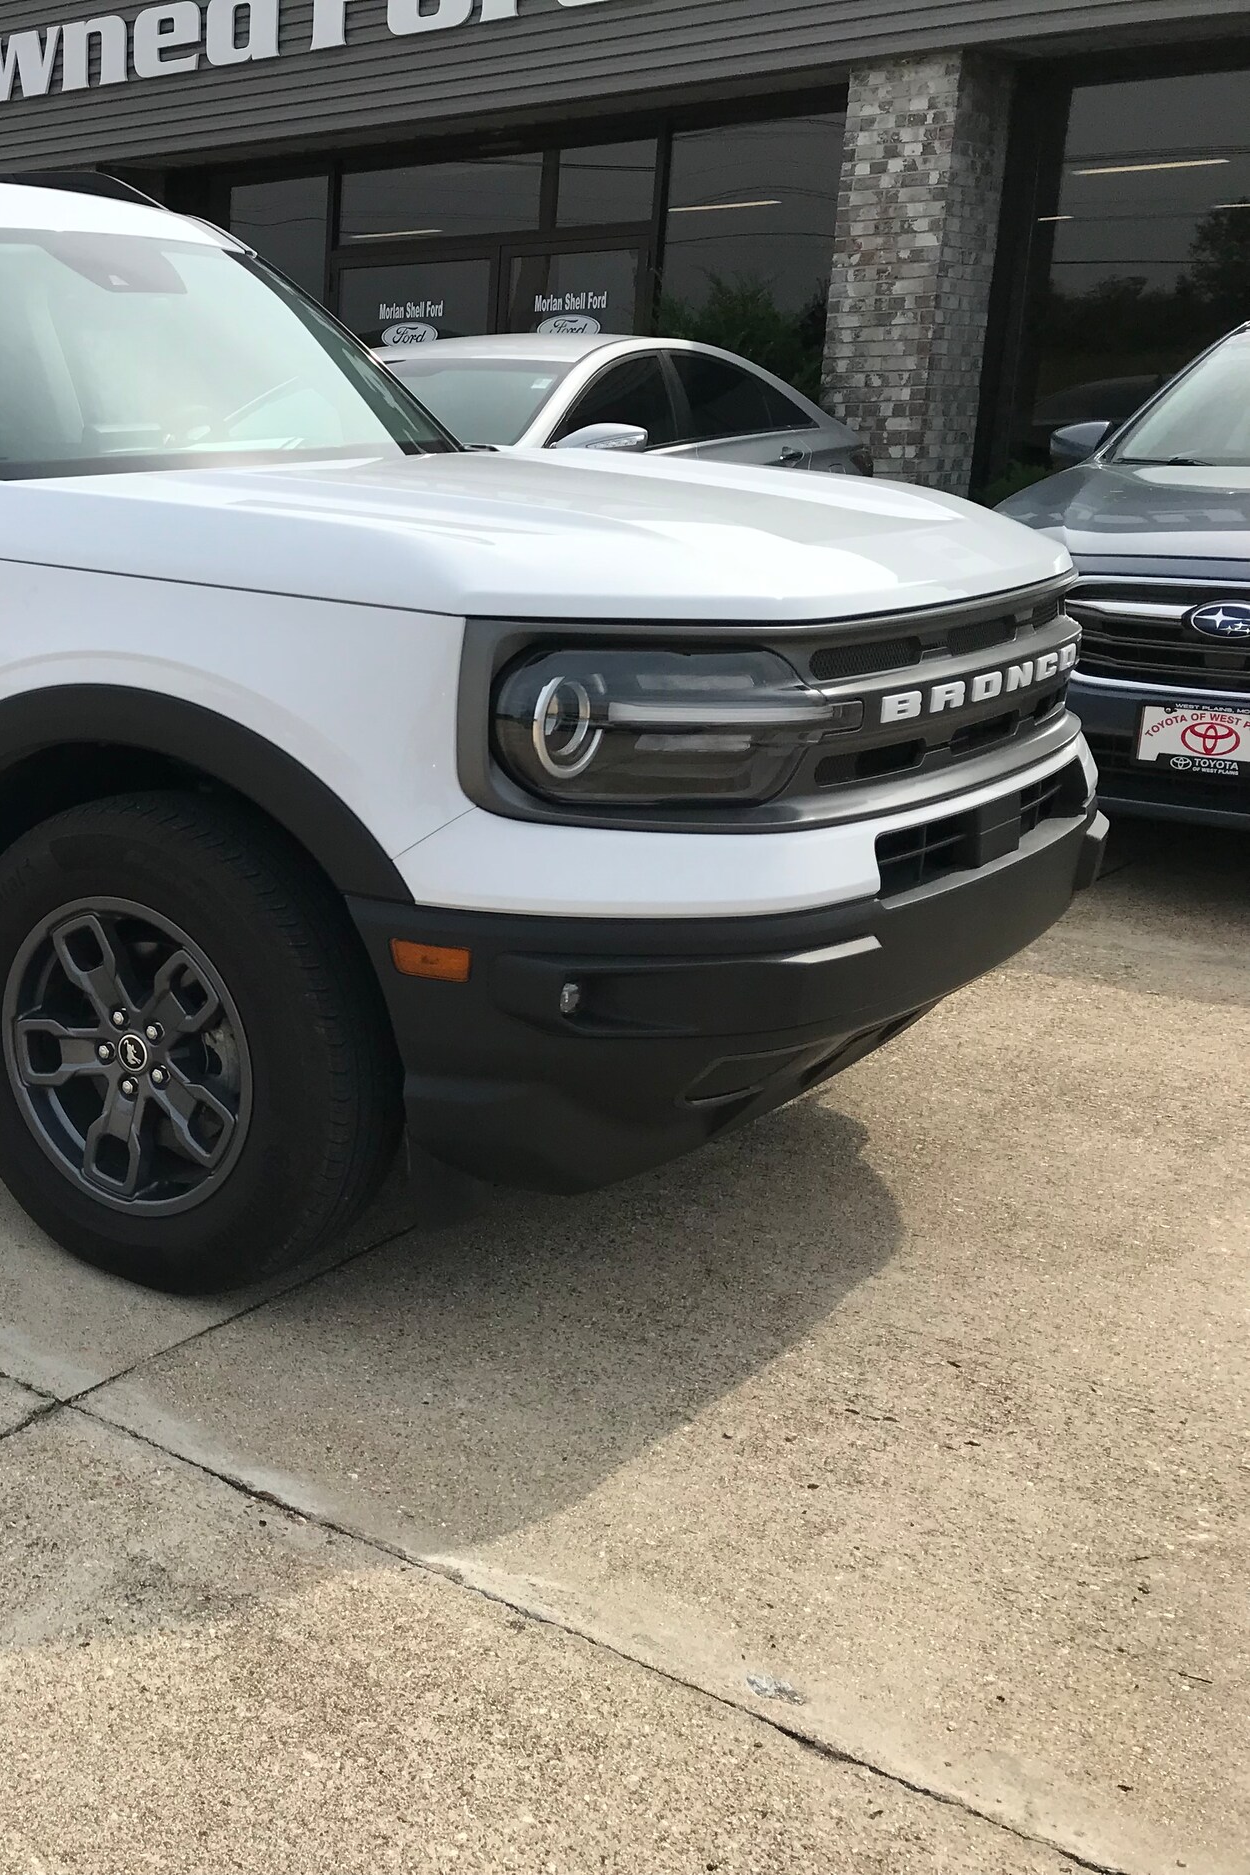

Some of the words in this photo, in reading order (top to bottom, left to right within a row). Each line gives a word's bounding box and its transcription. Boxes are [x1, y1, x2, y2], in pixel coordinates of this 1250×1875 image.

[379, 303, 404, 319] Morlan
[405, 302, 425, 318] Shell
[426, 300, 443, 317] Ford
[534, 294, 563, 312] Morlan
[564, 292, 586, 310] Shell
[587, 291, 607, 309] Ford
[392, 326, 427, 344] Ford
[880, 643, 1079, 724] BRONCO
[1145, 714, 1188, 737] TOYOTA
[1190, 712, 1206, 721] OF
[1209, 712, 1242, 726] WEST
[1194, 758, 1239, 770] TOYOTA
